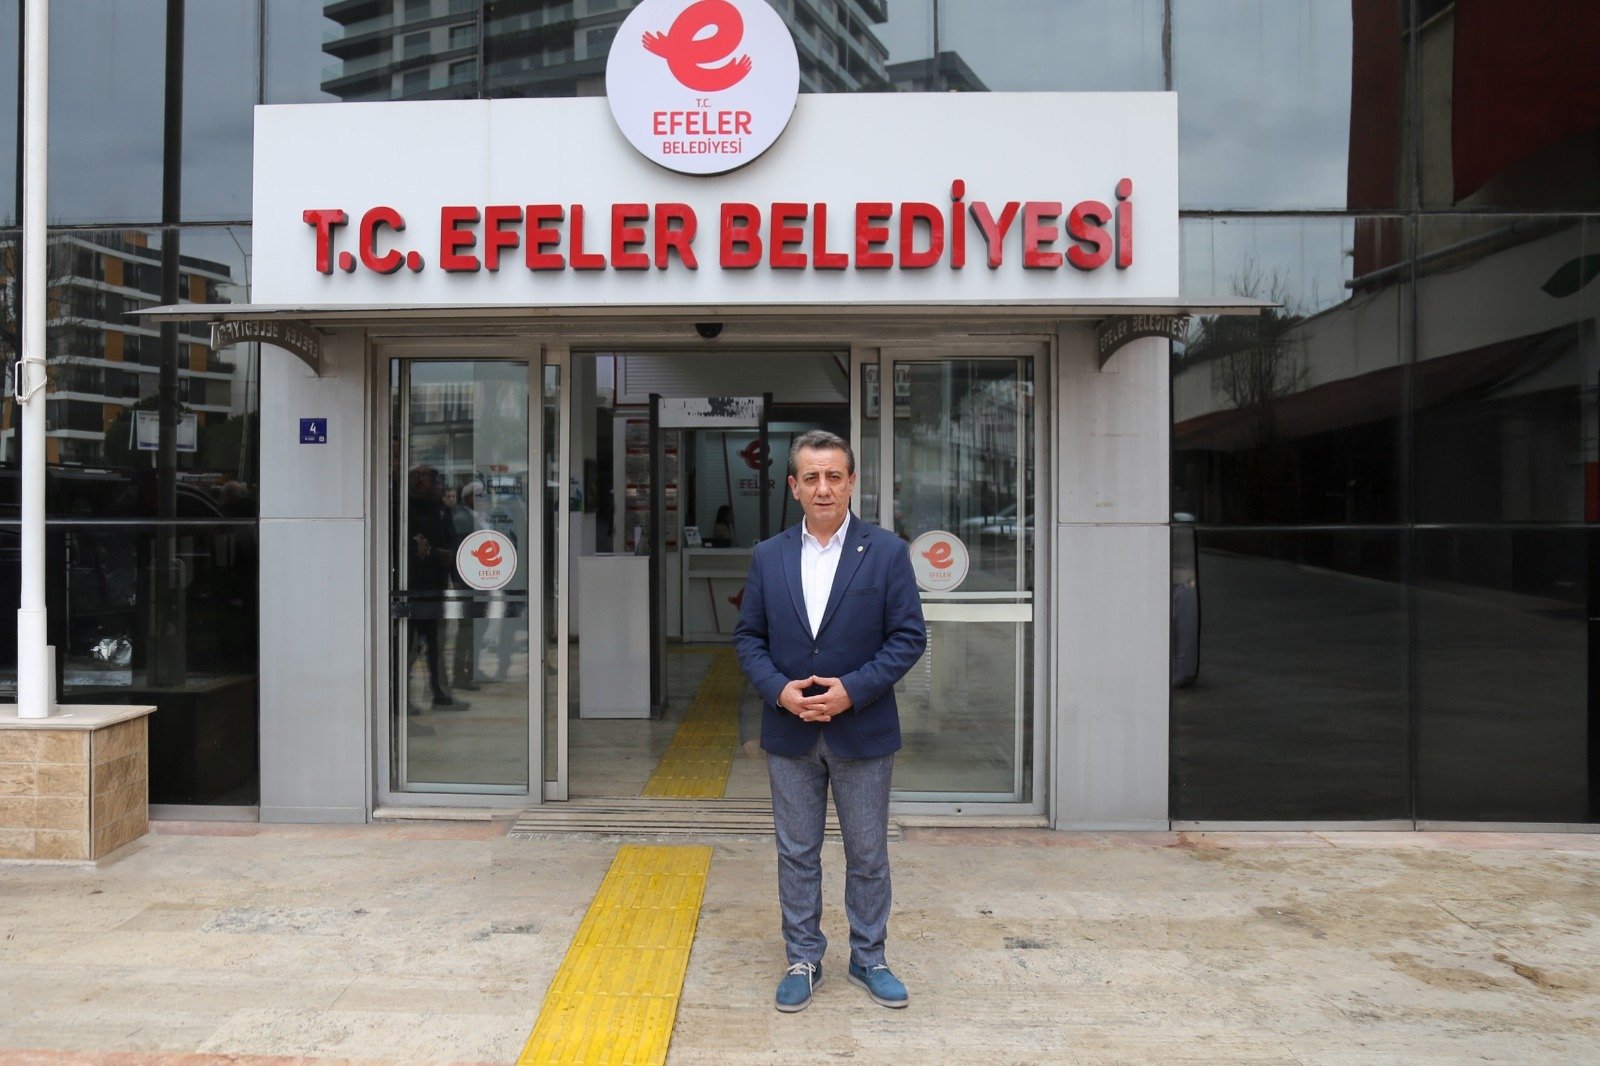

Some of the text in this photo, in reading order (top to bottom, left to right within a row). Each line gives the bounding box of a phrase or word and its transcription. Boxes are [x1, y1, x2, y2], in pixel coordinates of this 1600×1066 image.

[696, 98, 712, 108] T.C.
[653, 111, 752, 135] EFELER
[662, 138, 742, 154] BELEDİYESİ
[302, 177, 1133, 275] T.C. EFELER BELEDİYESİ
[310, 422, 317, 433] 4
